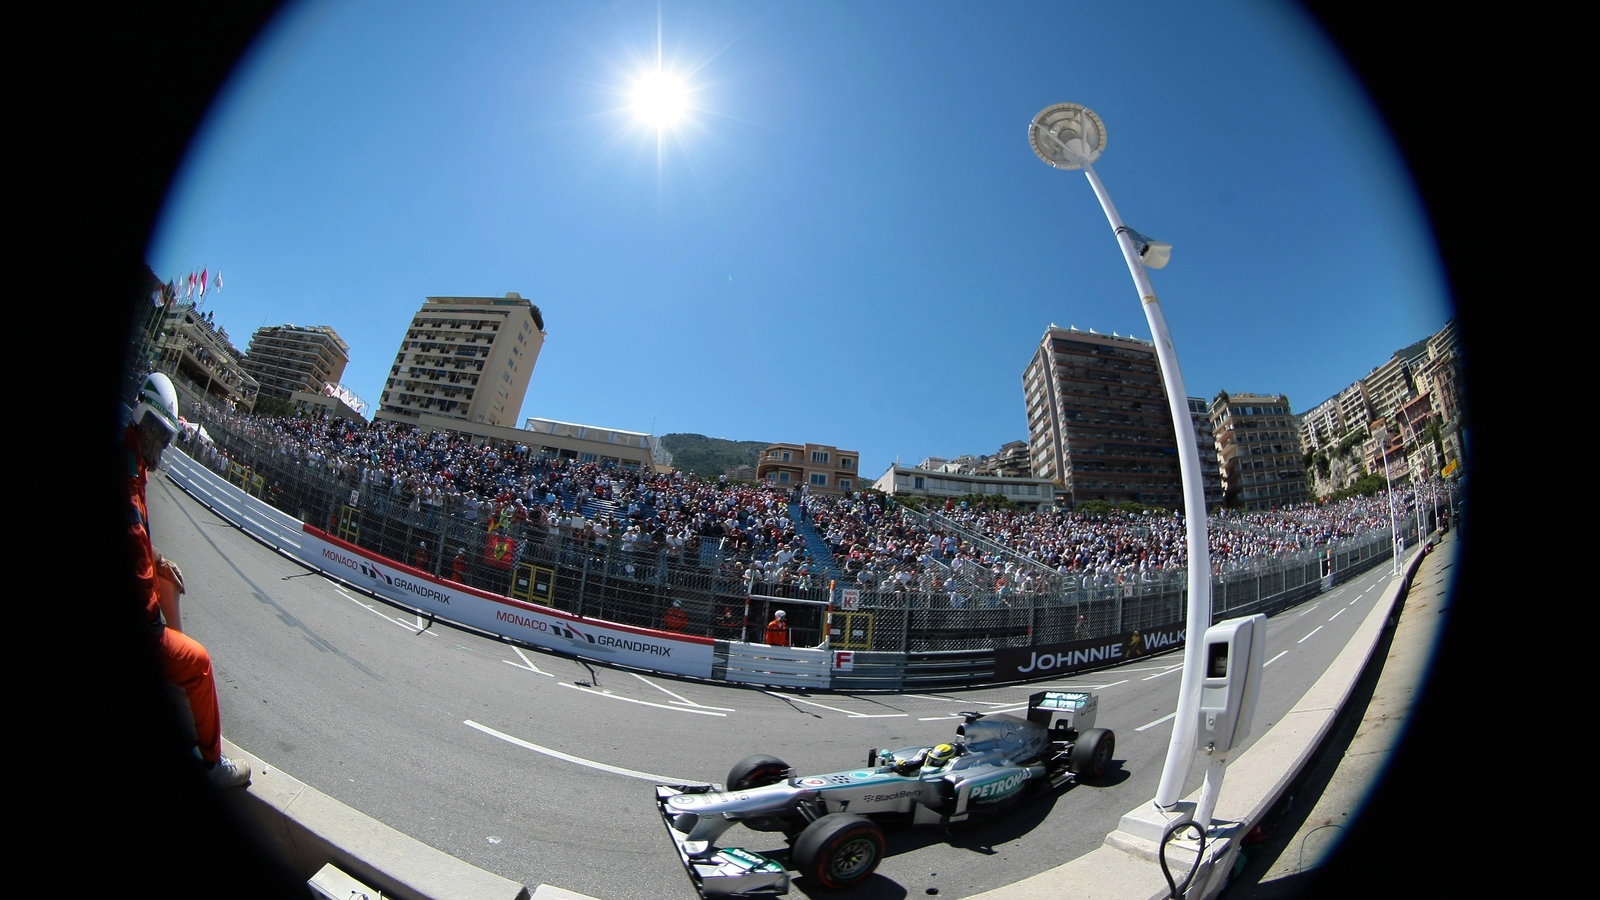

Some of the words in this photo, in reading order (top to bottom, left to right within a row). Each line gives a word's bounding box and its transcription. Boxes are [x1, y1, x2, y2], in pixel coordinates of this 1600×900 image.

[322, 548, 358, 570] MONACO
[394, 577, 450, 605] GRANDPRIX
[496, 610, 547, 632] MONACO
[597, 635, 672, 657] GRANDPRIX
[836, 652, 852, 669] F
[1017, 642, 1123, 673] JOHNNIE
[874, 789, 923, 802] BlackBerry
[970, 767, 1032, 798] PETRONAS
